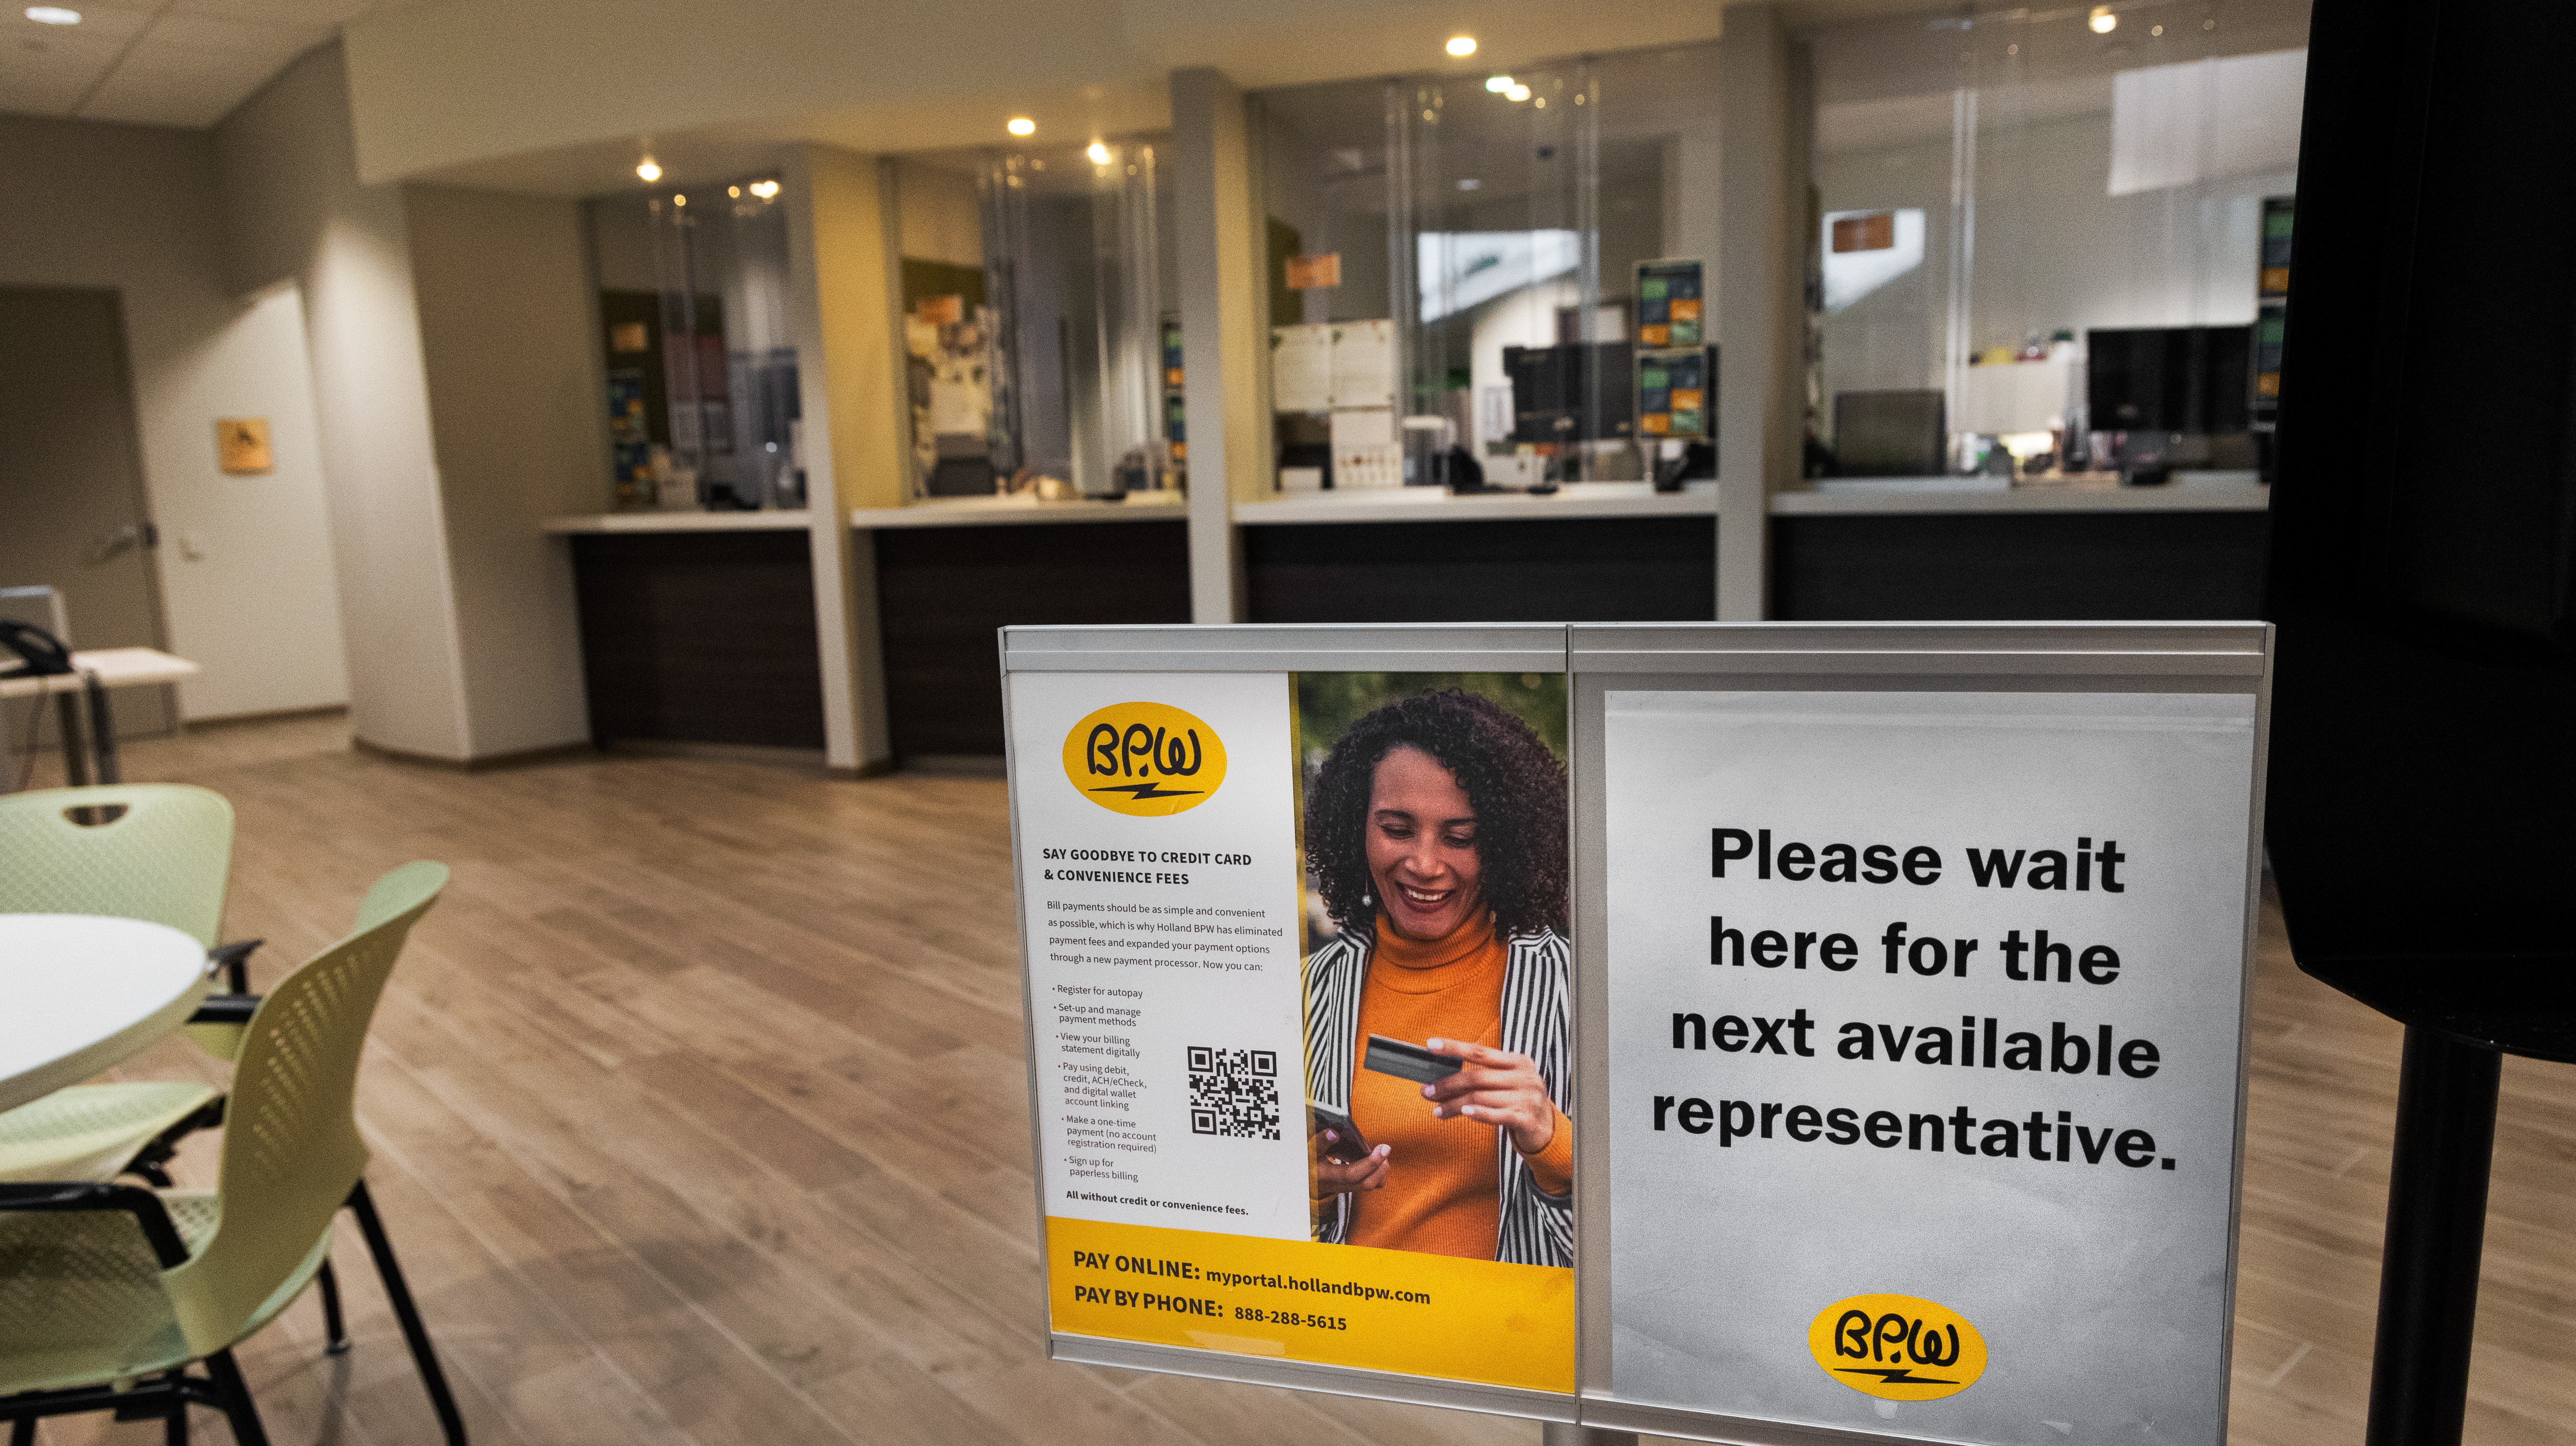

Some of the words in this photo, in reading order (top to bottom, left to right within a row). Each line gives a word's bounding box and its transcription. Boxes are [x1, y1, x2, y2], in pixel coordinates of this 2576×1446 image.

[1043, 848, 1066, 859] SAY
[1071, 849, 1134, 861] GOODBYE
[1138, 852, 1157, 862] TO
[1161, 852, 1210, 864] CREDIT
[1215, 854, 1251, 865] CARD
[1712, 828, 1941, 885] Please
[1966, 837, 2125, 893] wait
[1045, 869, 1053, 880] &
[1057, 870, 1151, 883] CONVENIENCE
[1157, 873, 1189, 884] FEES
[1047, 901, 1061, 909] Bill
[1063, 903, 1105, 912] payments
[1107, 903, 1136, 912] should
[1139, 905, 1150, 913] be
[1164, 907, 1193, 916] simple
[1215, 909, 1265, 917] convenient
[1059, 920, 1097, 930] possible,
[1099, 921, 1125, 929] which
[1128, 921, 1135, 930] is
[1136, 922, 1154, 932] why
[1157, 924, 1191, 932] Holland
[1194, 924, 1214, 933] BPW
[1217, 925, 1232, 934] has
[1234, 927, 1282, 936] eliminated
[1049, 937, 1087, 946] payment
[1088, 937, 1106, 946] fees
[1108, 939, 1124, 947] and
[1127, 940, 1169, 949] expanded
[1194, 944, 1233, 952] payment
[1236, 945, 1270, 954] options
[1711, 916, 1858, 972] here
[1882, 922, 1978, 977] for
[2000, 930, 2120, 985] the
[1050, 953, 1084, 964] through
[1114, 958, 1152, 966] payment
[1155, 960, 1200, 968] processor.
[1203, 961, 1223, 969] Now
[1057, 985, 1091, 996] Register
[1093, 986, 1104, 995] for
[1107, 989, 1143, 999] autopay
[1059, 1003, 1086, 1014] Set-up
[1088, 1006, 1104, 1014] and
[1107, 1008, 1141, 1018] manage
[1059, 1016, 1096, 1024] payment
[1098, 1018, 1136, 1027] methods
[1060, 1033, 1080, 1041] View
[1104, 1036, 1130, 1047] billing
[1673, 1009, 1814, 1057] next
[1837, 1016, 2160, 1079] available
[1062, 1044, 1103, 1054] statement
[1106, 1047, 1140, 1059] digitally
[1063, 1062, 1078, 1072] Pay
[1080, 1064, 1103, 1075] using
[1104, 1066, 1129, 1076] debit,
[1063, 1075, 1090, 1084] credit,
[1092, 1076, 1146, 1088] ACH/eCheck,
[1082, 1087, 1108, 1097] digital
[1111, 1090, 1135, 1098] wallet
[1100, 1100, 1129, 1111] linking
[1066, 1115, 1088, 1124] Make
[1098, 1119, 1136, 1128] one-time
[1067, 1128, 1103, 1137] payment
[1106, 1130, 1120, 1138] (no
[1122, 1133, 1156, 1141] account
[1654, 1096, 2176, 1171] representative.
[1068, 1139, 1115, 1149] registration
[1118, 1143, 1156, 1153] required)
[1069, 1156, 1087, 1166] Sign
[1102, 1158, 1113, 1167] for
[1070, 1169, 1110, 1178] paperless
[1112, 1171, 1138, 1182] billing
[1066, 1191, 1079, 1199] All
[1080, 1192, 1117, 1203] without
[1120, 1197, 1147, 1205] credit
[1162, 1201, 1223, 1213] convenience
[1225, 1205, 1248, 1215] fees.
[1074, 1251, 1109, 1269] PAY
[1115, 1255, 1199, 1279] ONLINE:
[1207, 1271, 1430, 1304] myportal.hollandbpw.com
[1075, 1285, 1110, 1304] PAY
[1115, 1290, 1139, 1307] BY
[1143, 1293, 1223, 1317] PHONE:
[1235, 1307, 1346, 1331] 888-288-5615
